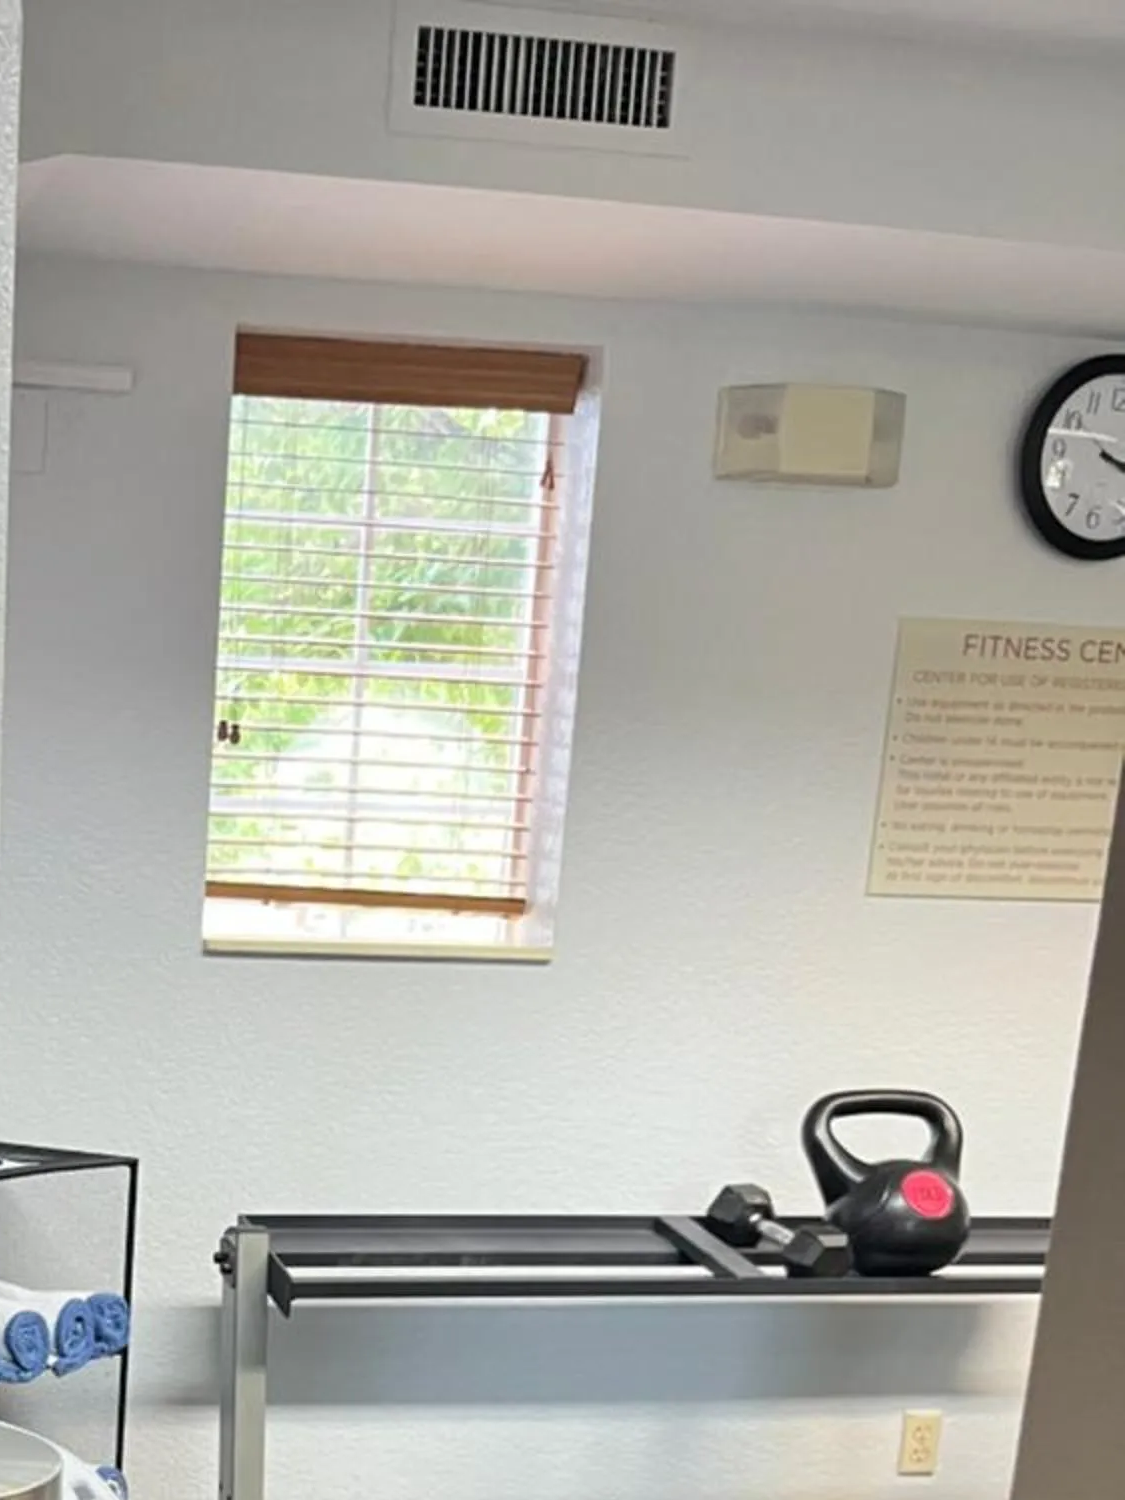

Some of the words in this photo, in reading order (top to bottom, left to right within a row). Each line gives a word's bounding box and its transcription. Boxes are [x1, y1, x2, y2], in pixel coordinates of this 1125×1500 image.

[1065, 492, 1081, 517] 7
[1086, 505, 1102, 530] 6
[962, 633, 1071, 662] FITNESS
